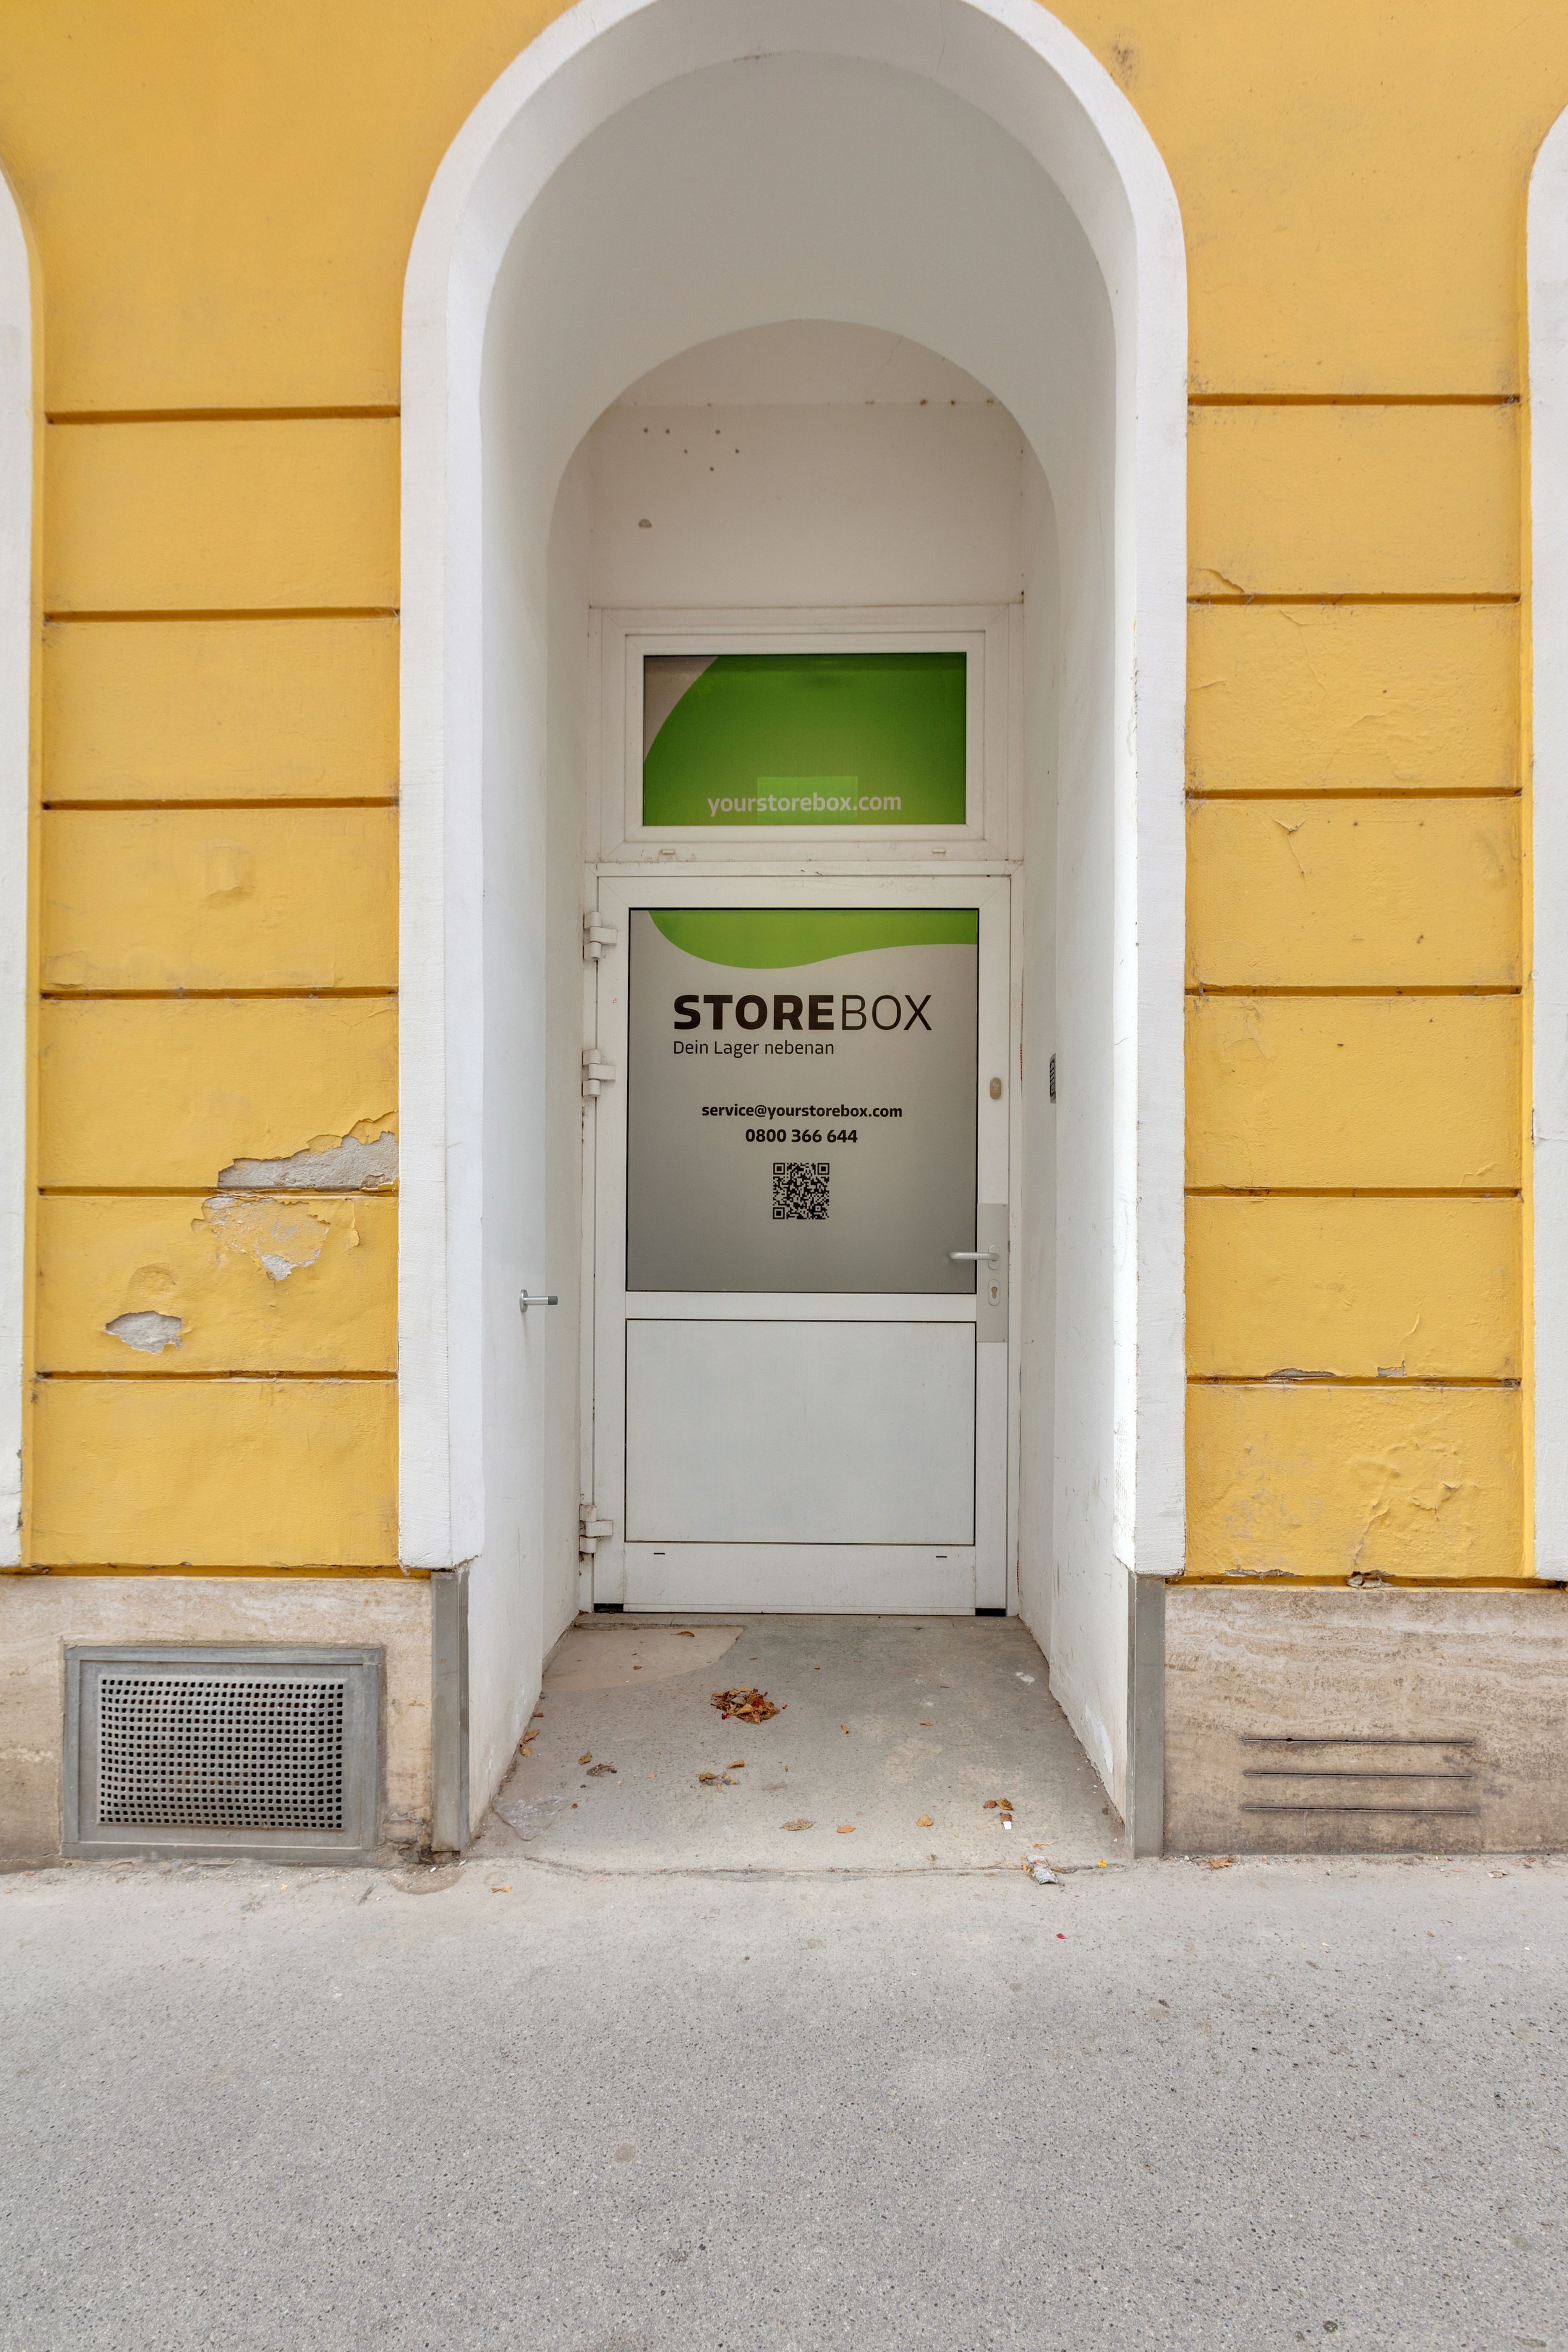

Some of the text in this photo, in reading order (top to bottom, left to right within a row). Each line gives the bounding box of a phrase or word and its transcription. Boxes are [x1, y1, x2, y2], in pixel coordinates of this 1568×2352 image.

[708, 792, 902, 816] yourstorebox.com
[674, 995, 932, 1030] STOREBOX
[674, 1040, 834, 1058] Dein Lager nebenan
[702, 1104, 902, 1119] service@yourstorebox.com
[745, 1129, 858, 1143] 0800 366 644
